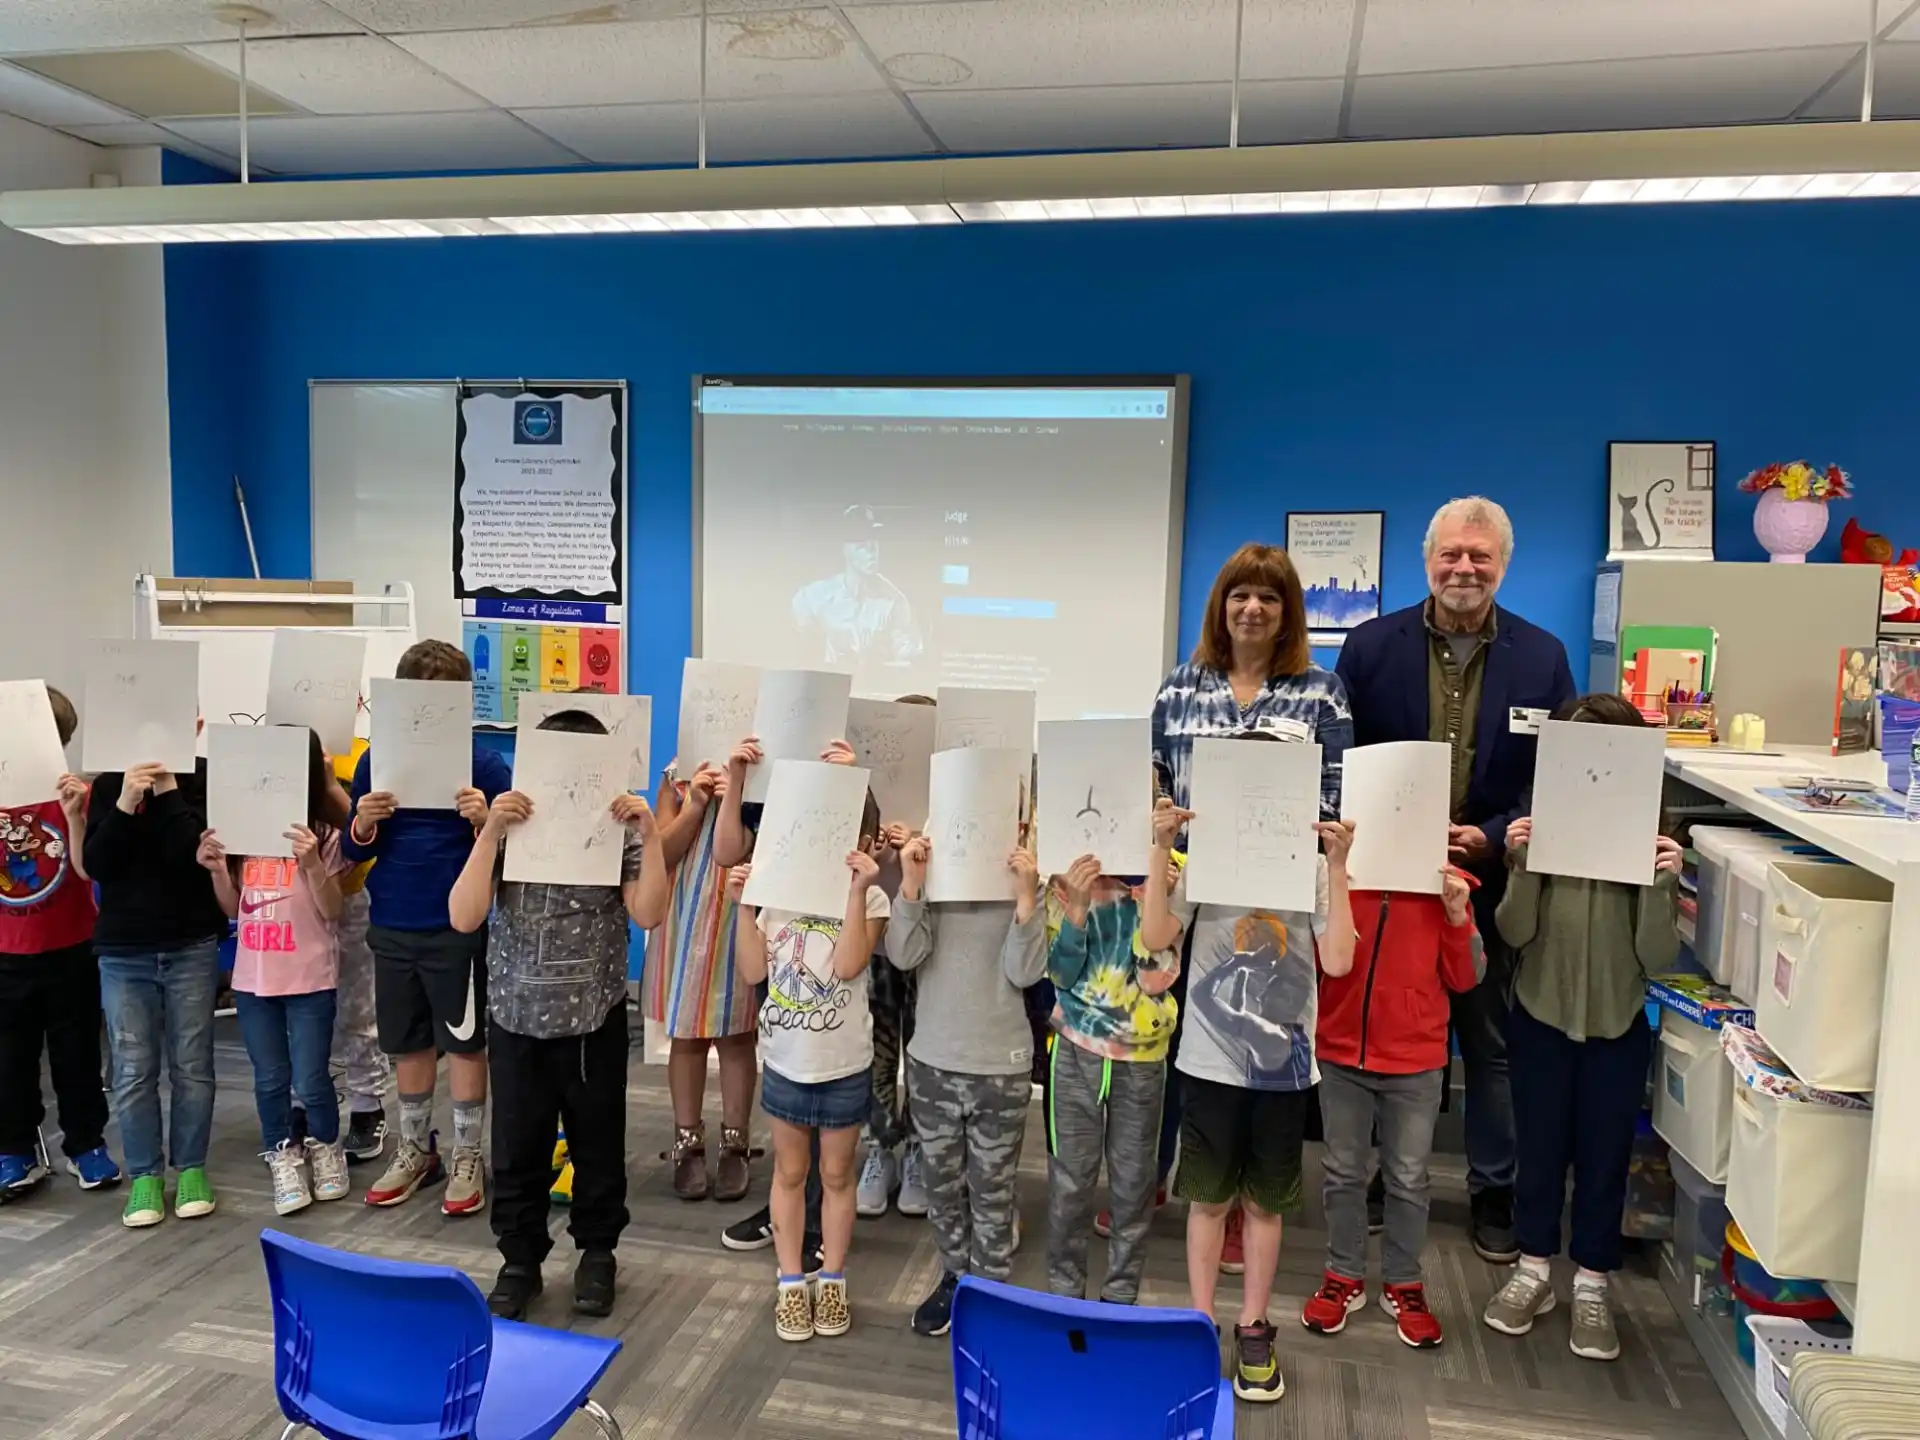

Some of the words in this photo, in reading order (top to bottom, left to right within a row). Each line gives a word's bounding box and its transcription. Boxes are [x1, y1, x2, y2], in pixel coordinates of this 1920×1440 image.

[1294, 539, 1308, 548] you
[502, 602, 526, 614] Zones
[527, 604, 538, 616] of
[540, 604, 583, 618] Regulation
[512, 676, 528, 684] Happy
[242, 858, 298, 888] GET
[1676, 998, 1702, 1019] LADDERS
[762, 1004, 844, 1037] peace
